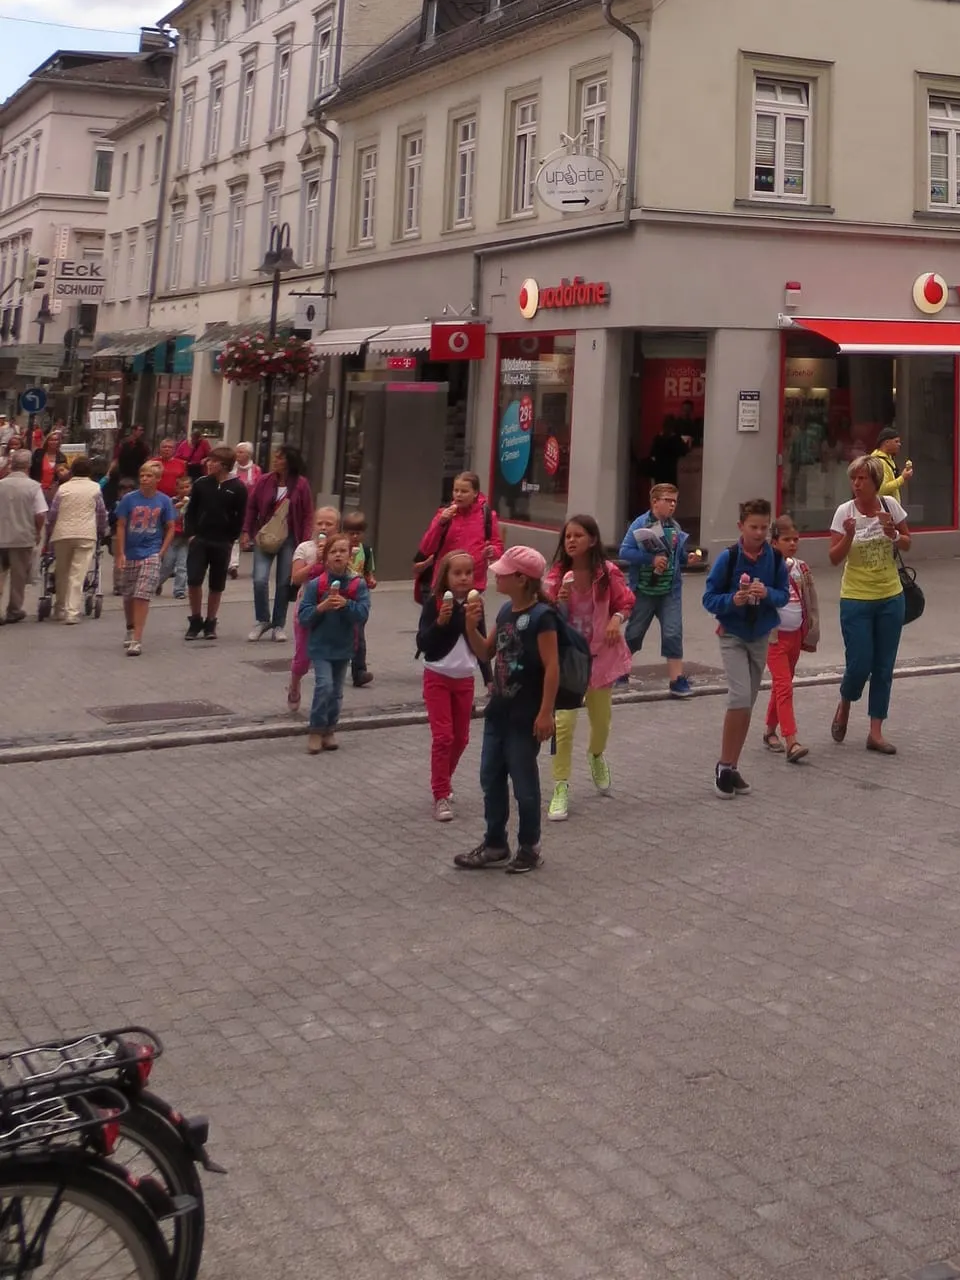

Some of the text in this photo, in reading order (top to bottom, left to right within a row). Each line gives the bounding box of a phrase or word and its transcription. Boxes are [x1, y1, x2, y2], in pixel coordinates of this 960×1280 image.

[61, 261, 103, 277] Eck
[56, 283, 105, 296] SCHMIDT
[665, 367, 704, 377] Vodafon
[664, 377, 705, 397] RED
